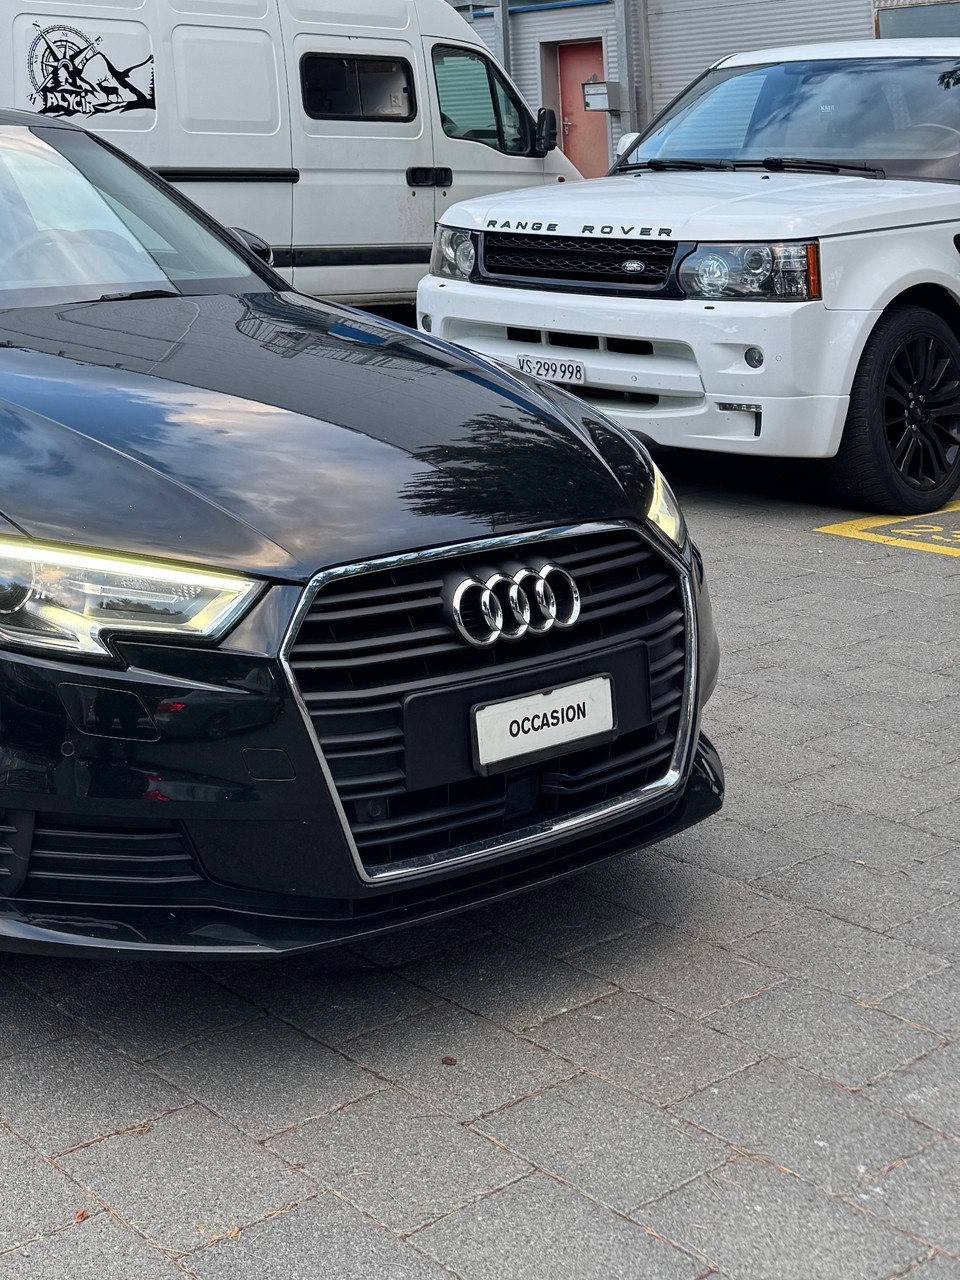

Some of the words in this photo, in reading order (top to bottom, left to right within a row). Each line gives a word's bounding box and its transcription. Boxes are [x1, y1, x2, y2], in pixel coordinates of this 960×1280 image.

[487, 220, 559, 232] RANGE
[581, 225, 673, 237] ROVER
[509, 702, 587, 738] OCCASION
